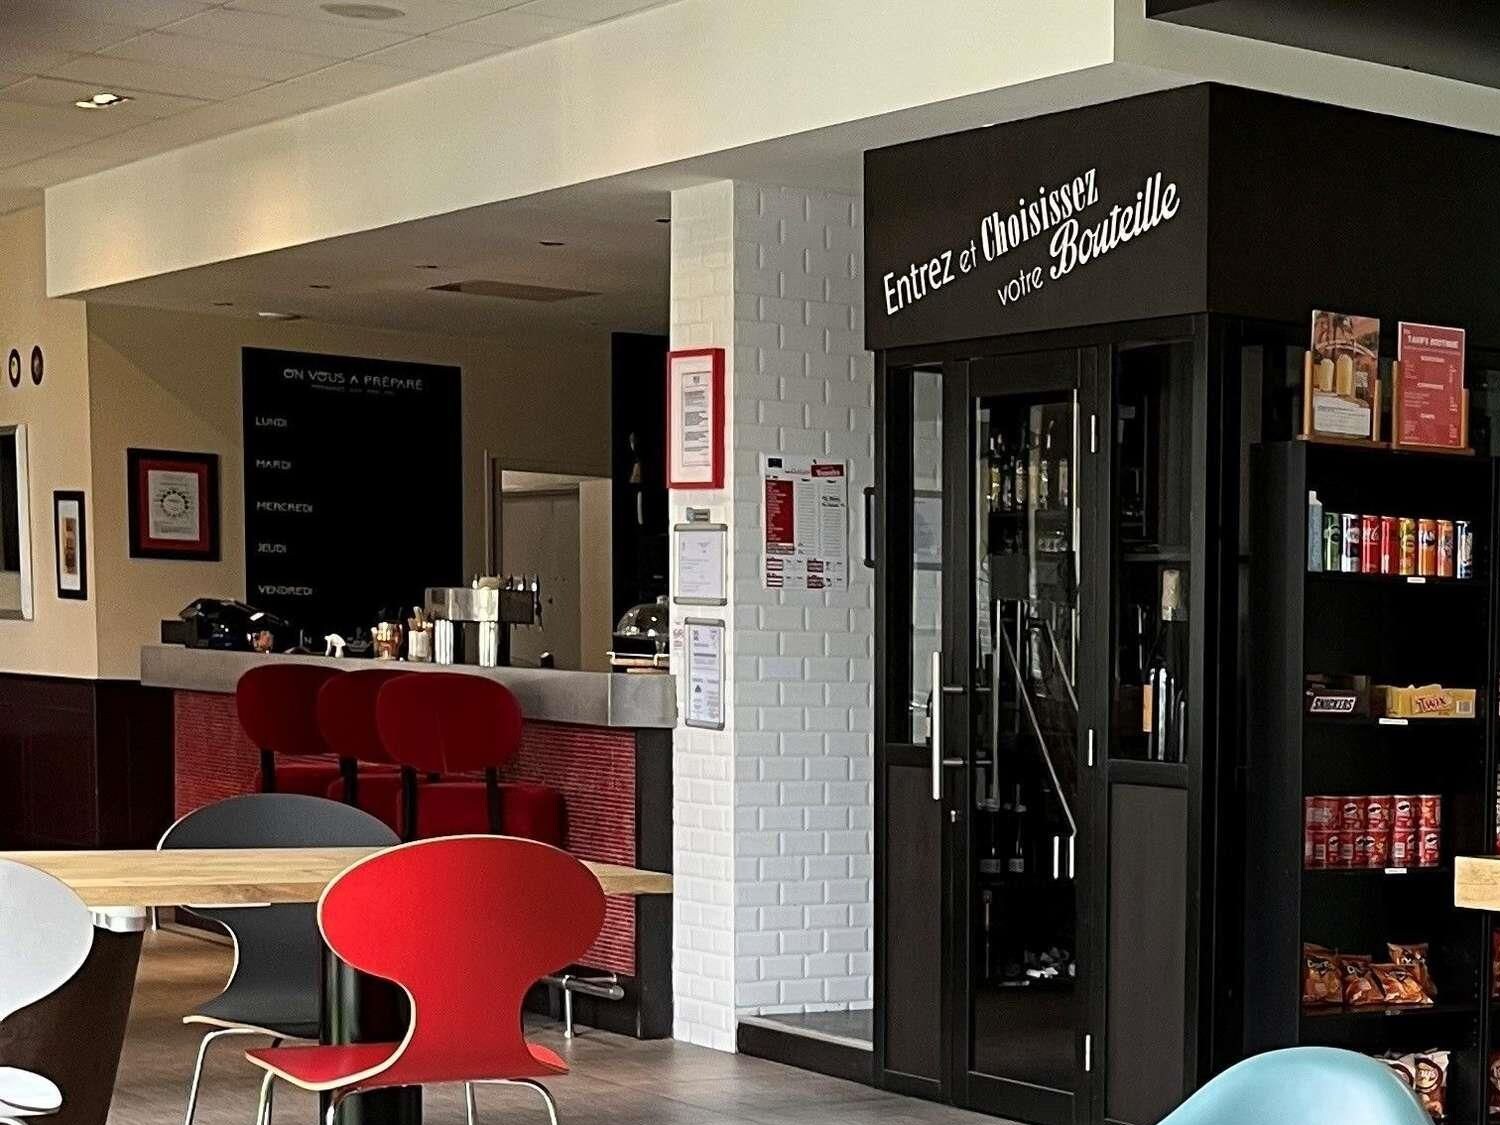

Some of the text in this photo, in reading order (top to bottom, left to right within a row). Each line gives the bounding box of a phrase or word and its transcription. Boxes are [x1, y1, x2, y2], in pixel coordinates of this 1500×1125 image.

[883, 168, 1099, 315] Entrez et Choisissez
[997, 172, 1181, 306] votre Bouteille
[283, 368, 304, 380] ON
[307, 369, 345, 384] VOUS
[255, 416, 288, 428] LUNDI
[256, 459, 292, 470] MARDI
[256, 501, 313, 513] MERCREDI
[258, 543, 287, 553] JEUDI
[258, 585, 313, 596] VENDREDI
